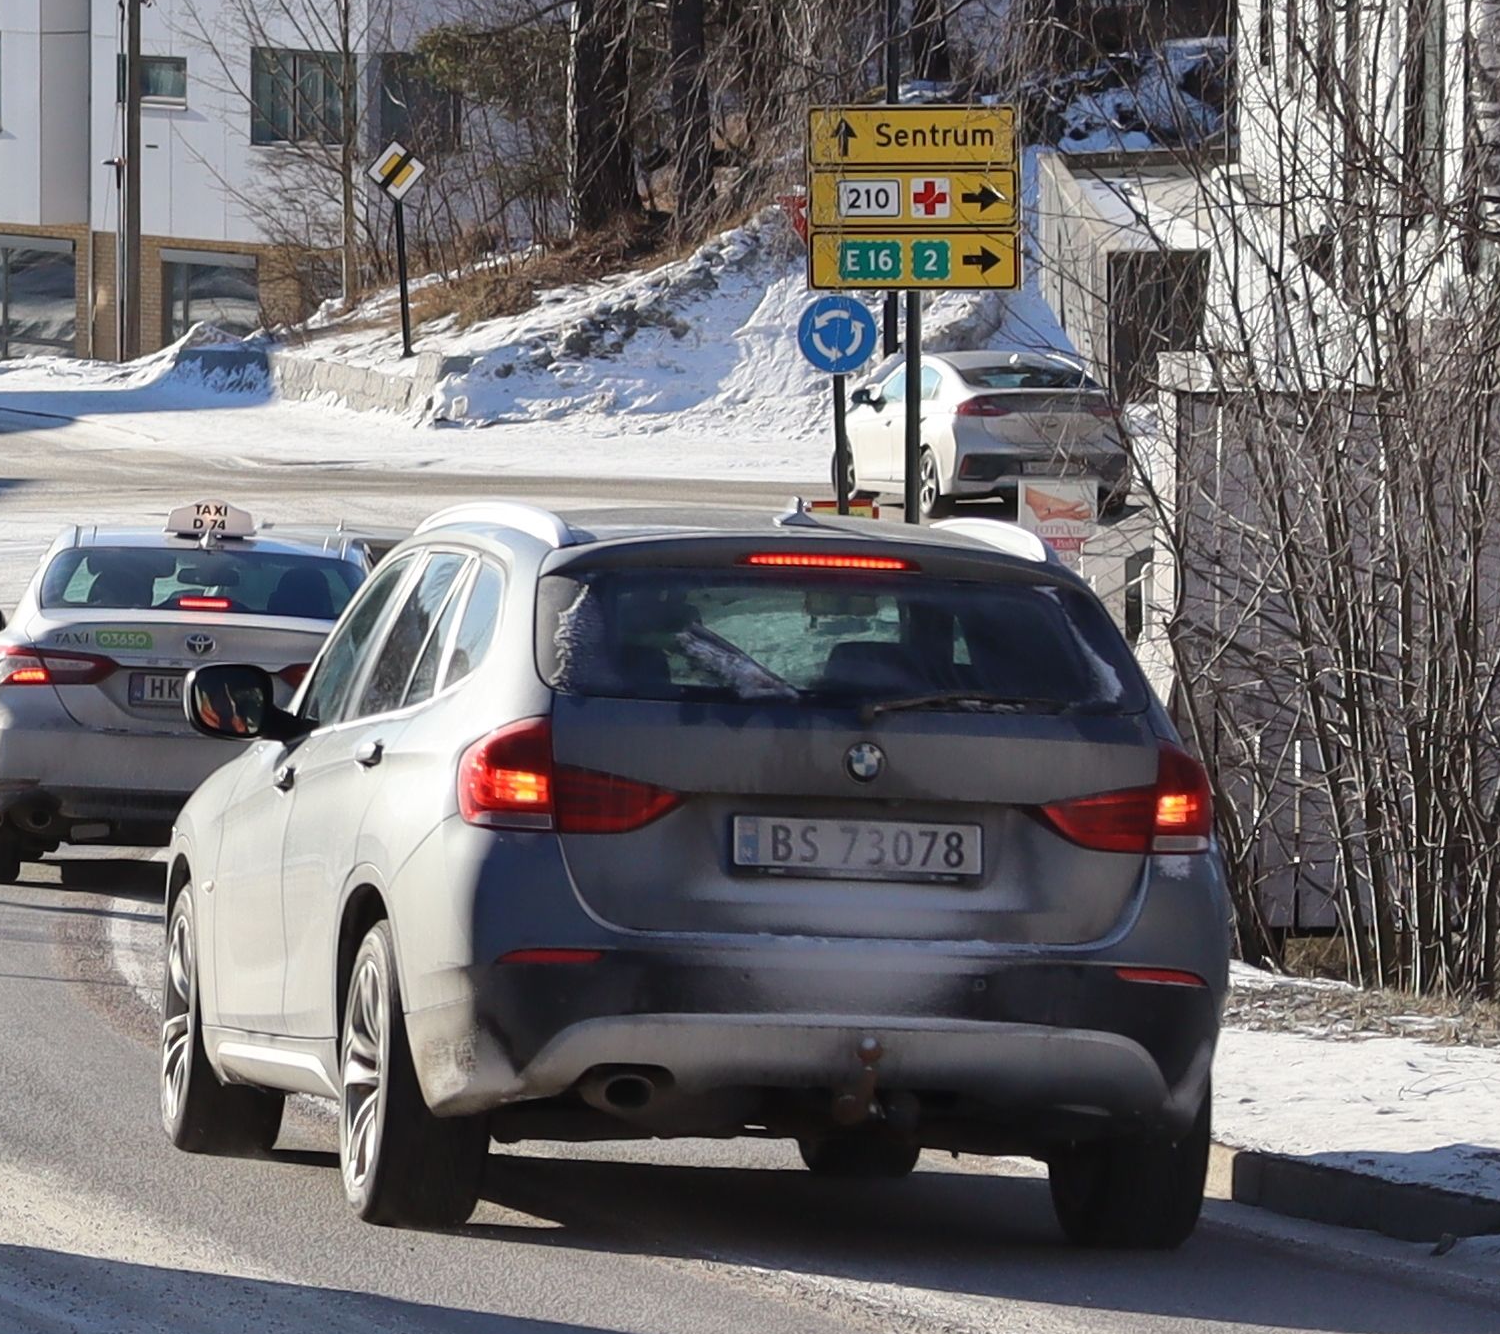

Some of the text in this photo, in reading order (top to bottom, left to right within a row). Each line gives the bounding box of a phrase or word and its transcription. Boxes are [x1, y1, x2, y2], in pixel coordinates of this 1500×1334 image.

[876, 123, 994, 147] Sentrum
[848, 188, 889, 209] 210
[847, 249, 893, 271] E 16
[924, 249, 938, 271] 2
[194, 504, 227, 516] TAXI
[193, 518, 226, 530] D 74
[54, 632, 148, 646] TAXI 03650
[151, 678, 182, 698] HK
[771, 824, 819, 863] BS
[840, 826, 964, 868] 73078
